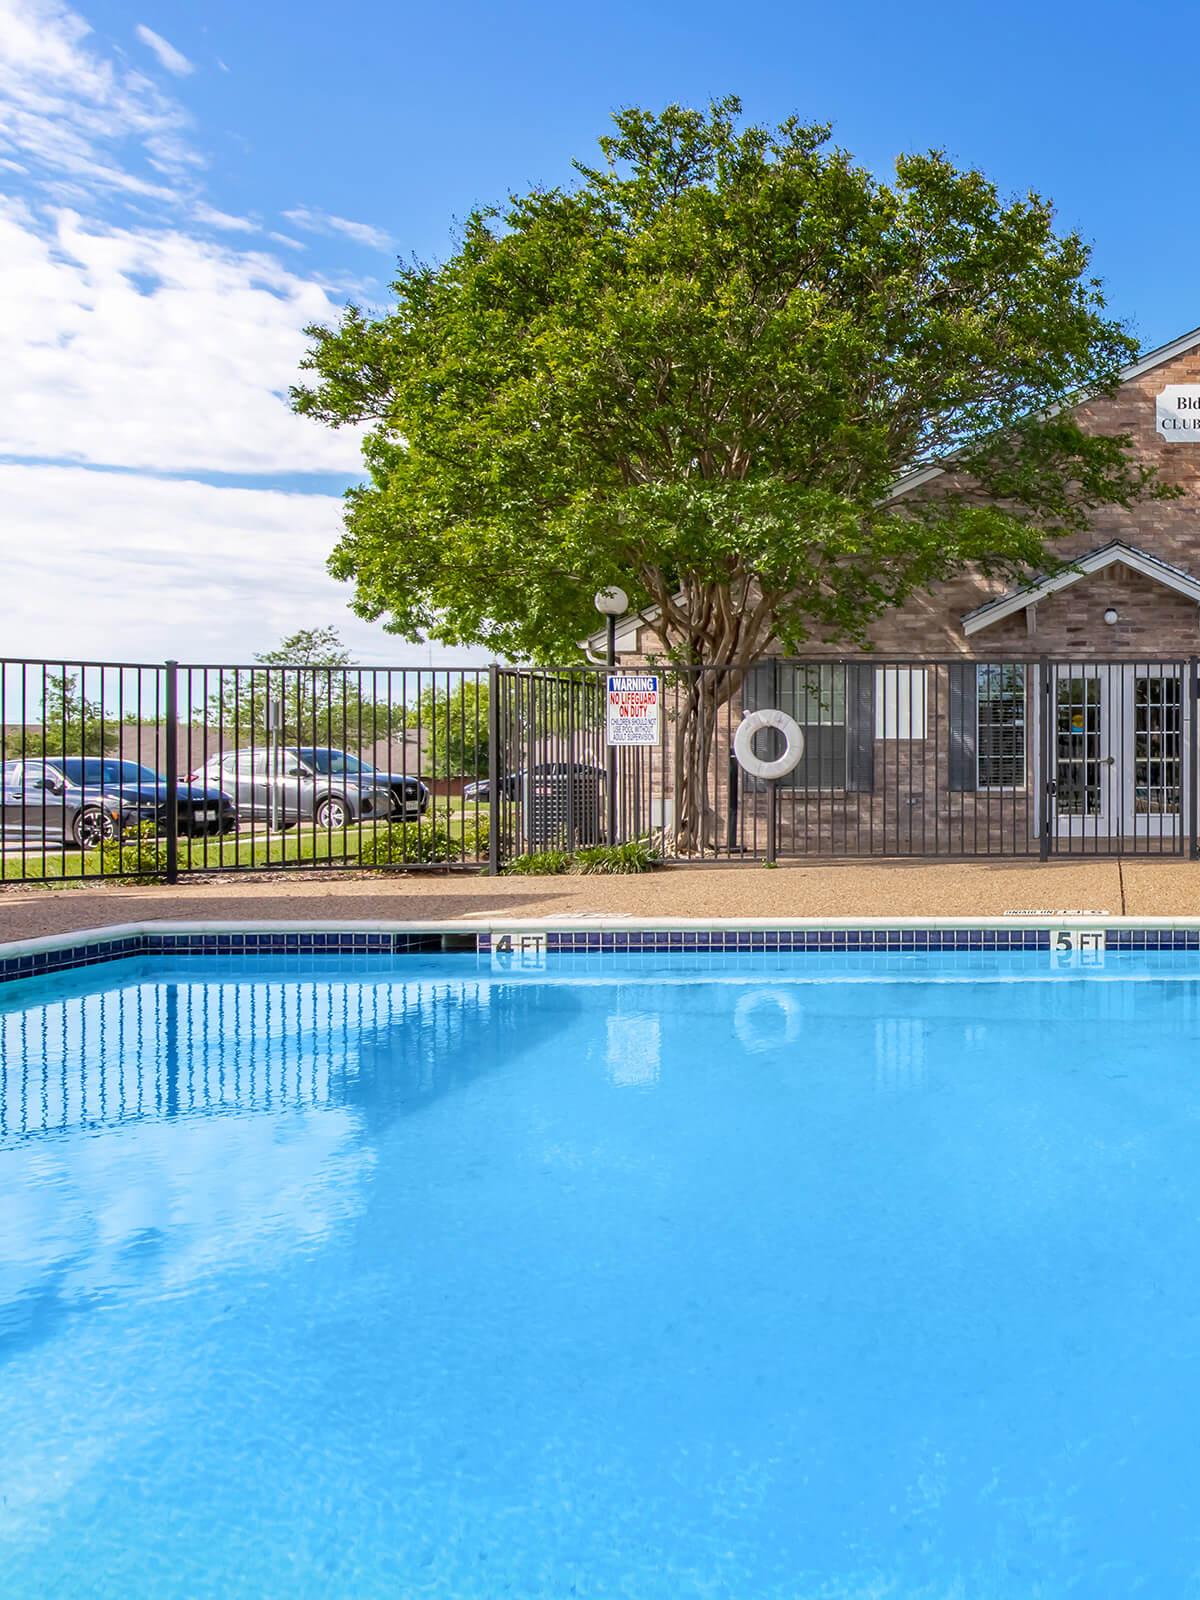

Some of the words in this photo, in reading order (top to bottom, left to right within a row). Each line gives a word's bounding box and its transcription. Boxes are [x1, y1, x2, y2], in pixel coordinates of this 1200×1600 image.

[613, 678, 654, 692] WARNING
[610, 692, 619, 704] NO
[621, 692, 656, 704] LIFEGUARD
[619, 705, 629, 717] ON
[630, 705, 648, 717] DUTY
[496, 935, 514, 953] 4
[521, 936, 543, 954] FT
[1056, 932, 1073, 951] 5
[1080, 933, 1103, 952] FT
